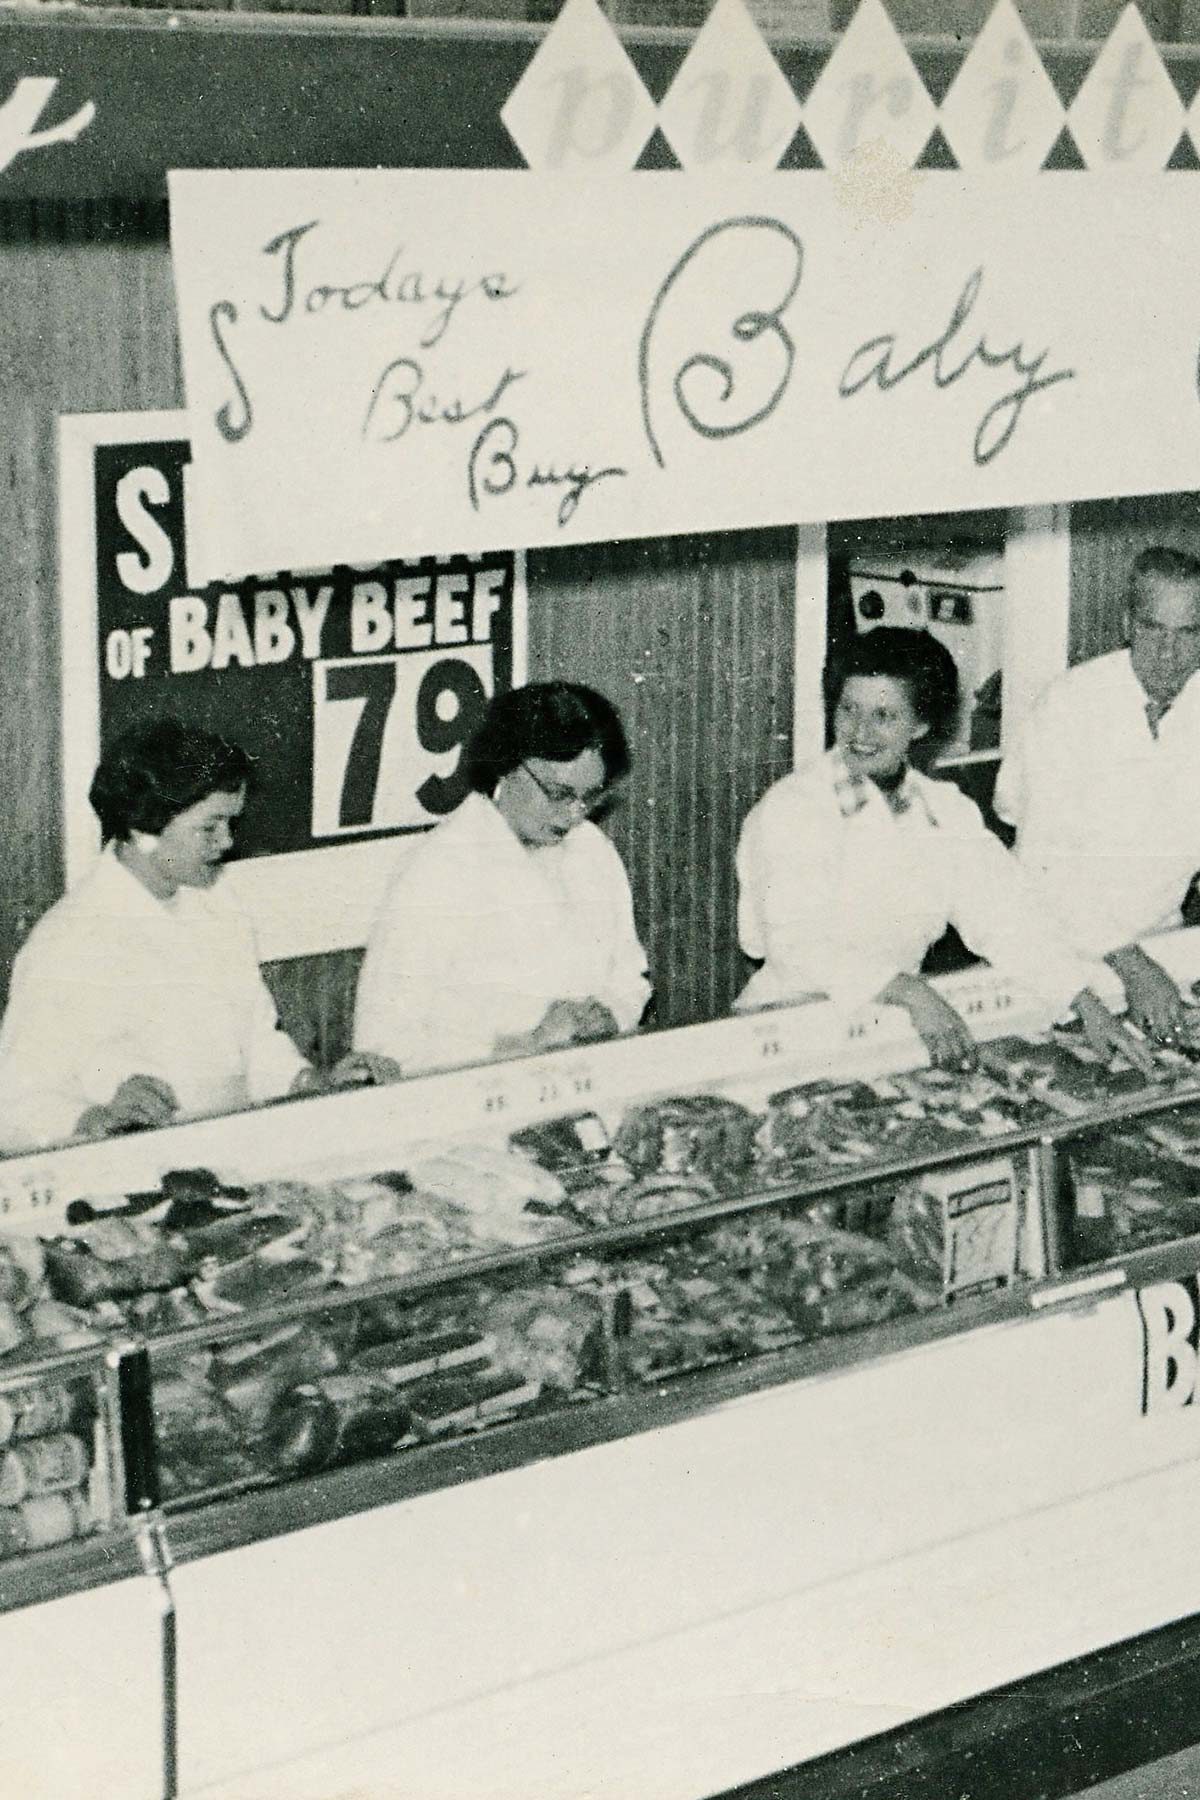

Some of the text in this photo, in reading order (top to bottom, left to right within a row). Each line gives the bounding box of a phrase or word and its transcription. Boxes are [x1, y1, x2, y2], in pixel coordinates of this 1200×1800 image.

[259, 220, 519, 349] Todays
[638, 215, 1077, 467] Baby
[360, 358, 527, 443] Best
[468, 417, 626, 526] Buy
[106, 627, 154, 681] OF
[169, 586, 334, 675] BABY
[351, 568, 508, 655] BEEF
[325, 657, 490, 830] 79
